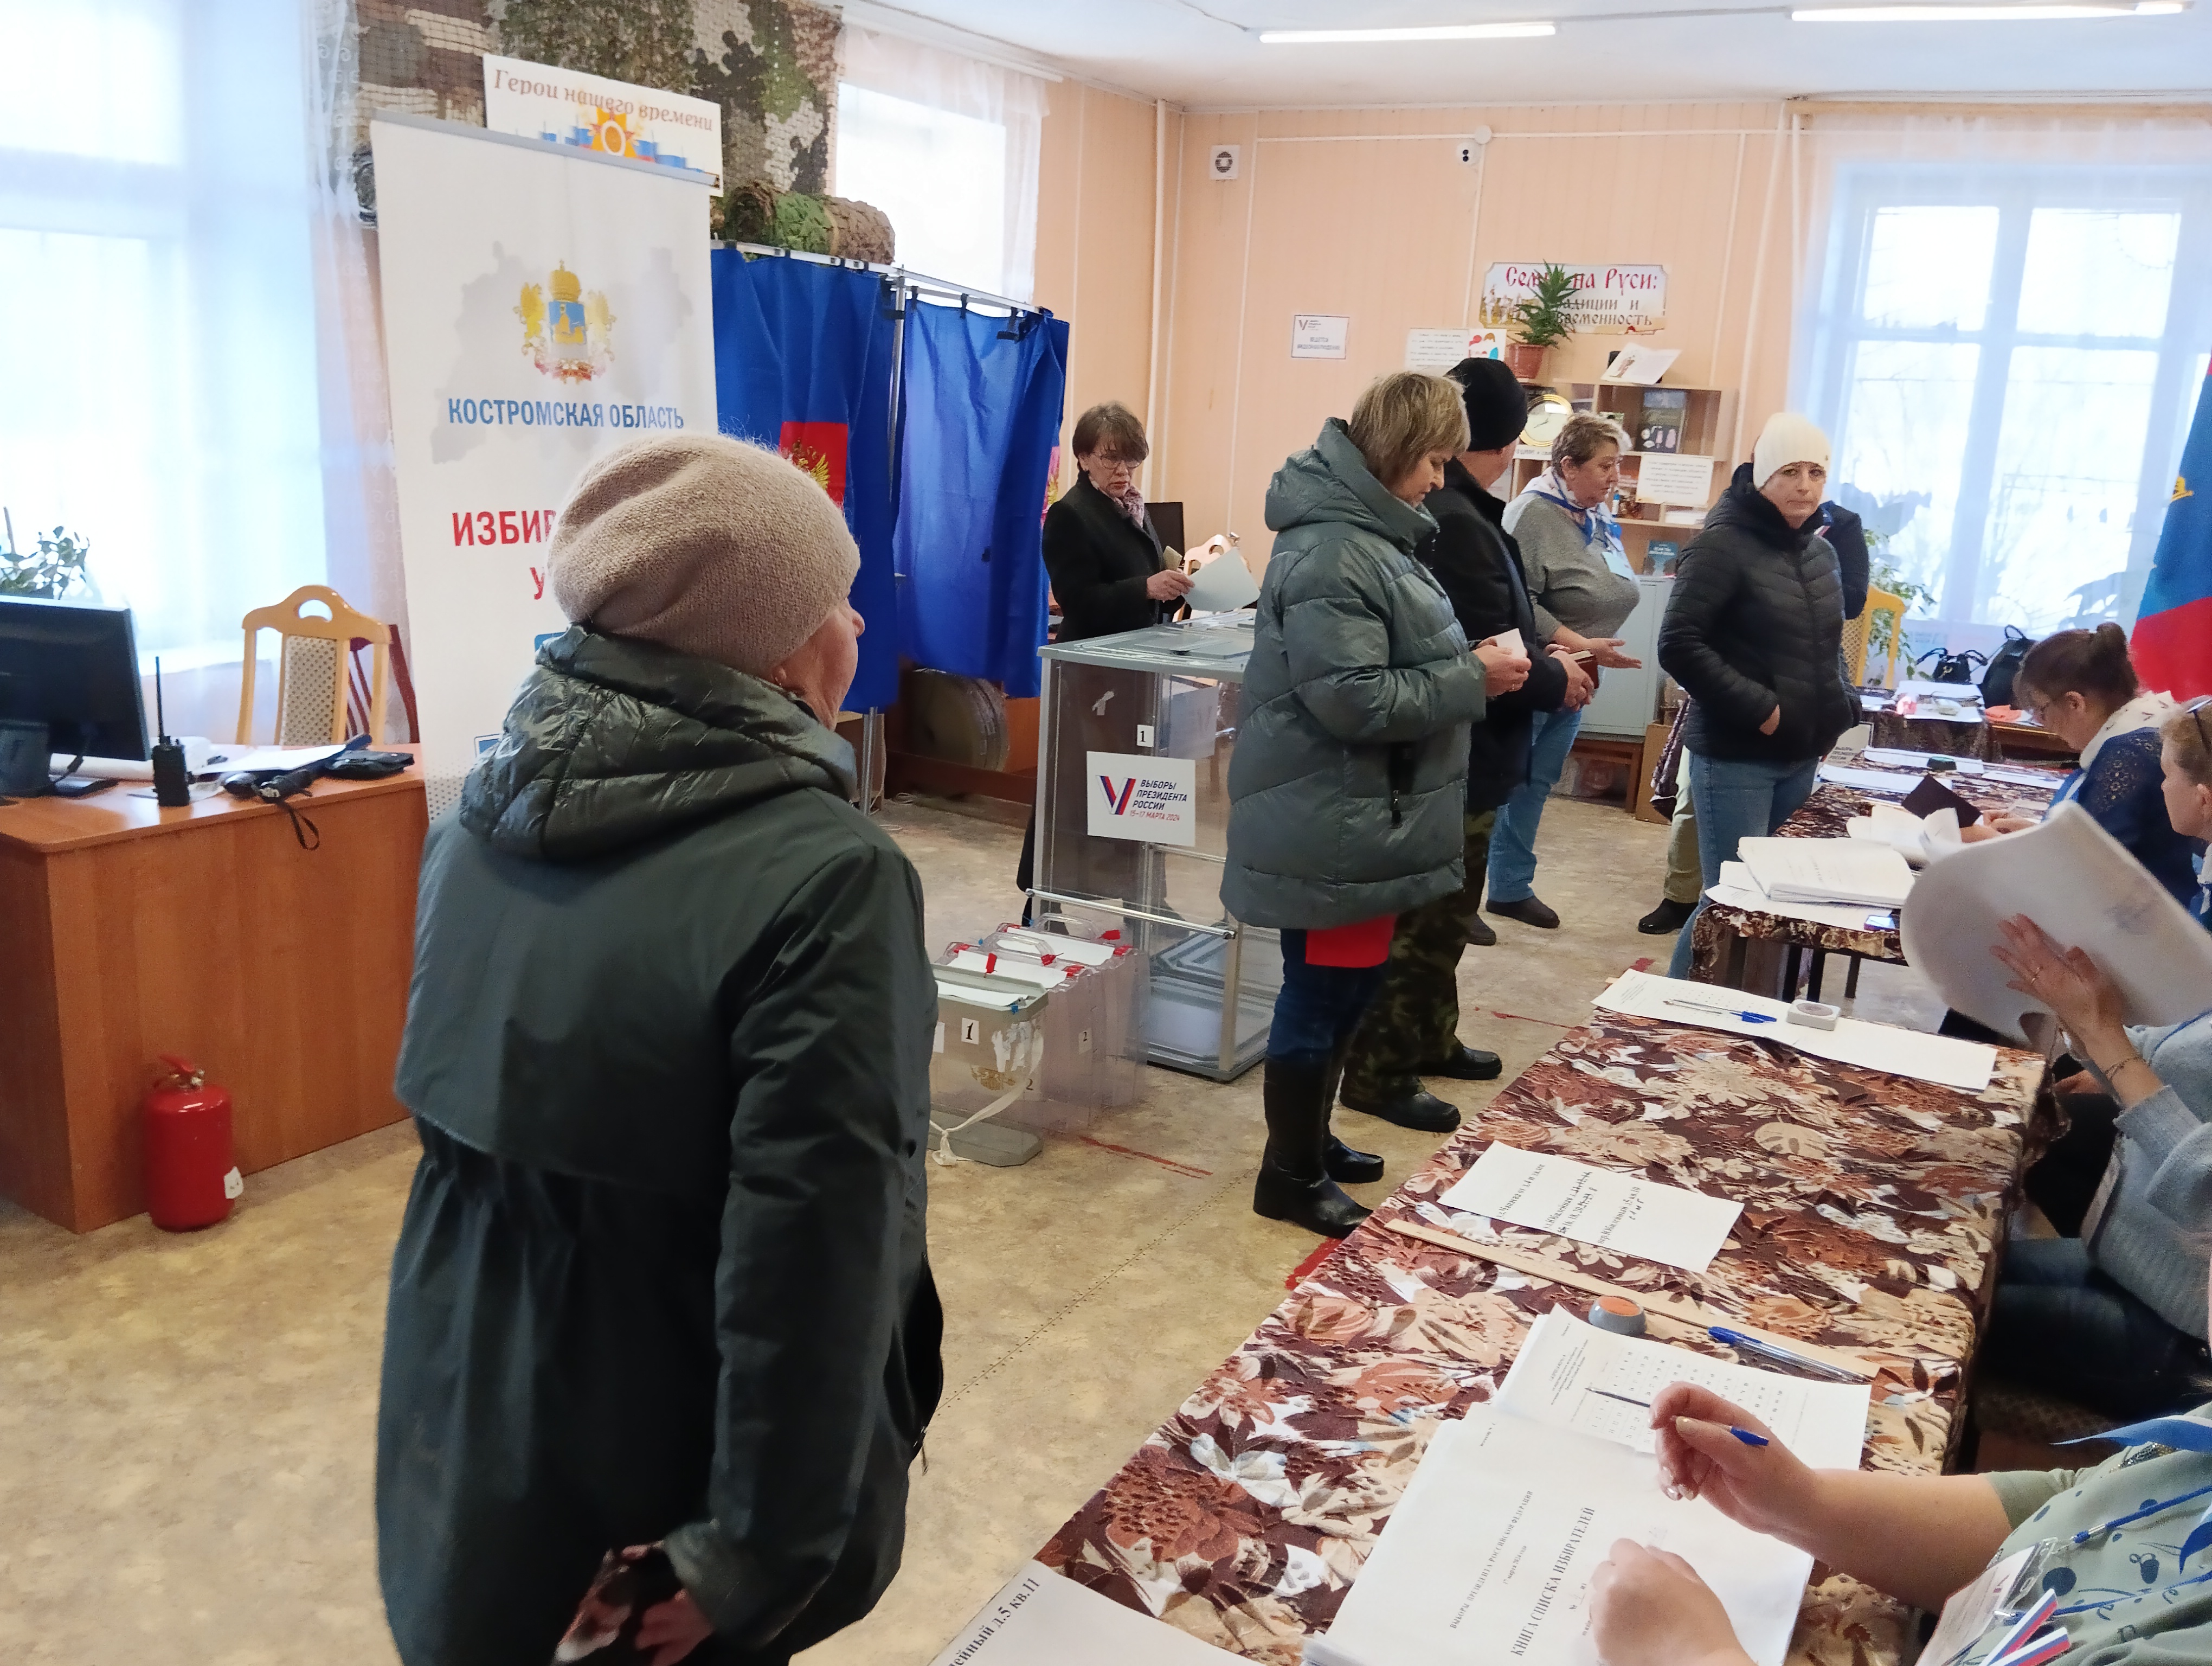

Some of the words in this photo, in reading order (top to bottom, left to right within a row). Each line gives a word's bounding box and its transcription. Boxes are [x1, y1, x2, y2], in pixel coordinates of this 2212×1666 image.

[494, 69, 558, 99] Герои
[564, 87, 634, 115] нашего
[639, 104, 712, 132] времени
[1605, 268, 1657, 296] Руси:
[448, 398, 603, 428] КОСТРОМСКАЯ
[609, 403, 684, 430] ОБЛАСТЬ
[1139, 730, 1147, 742] 1
[1140, 779, 1177, 790] ВЫБОРЫ
[1132, 800, 1165, 810] РОССИИ
[1136, 790, 1187, 802] ПРЕЗИДЕНТА
[1146, 812, 1165, 820] МАРТА
[966, 1022, 974, 1040] 1
[1025, 1078, 1034, 1091] 2
[1510, 1622, 1539, 1656] КНИГА
[1530, 1576, 1561, 1621] СПИСКА
[1552, 1507, 1595, 1574] ИЗБИРАТЕЛЕЙ
[948, 1625, 995, 1666] ейный
[991, 1606, 1012, 1629] д.5
[1009, 1578, 1040, 1610] кв.11
[1450, 1603, 1470, 1629] ВЫБОРЫ
